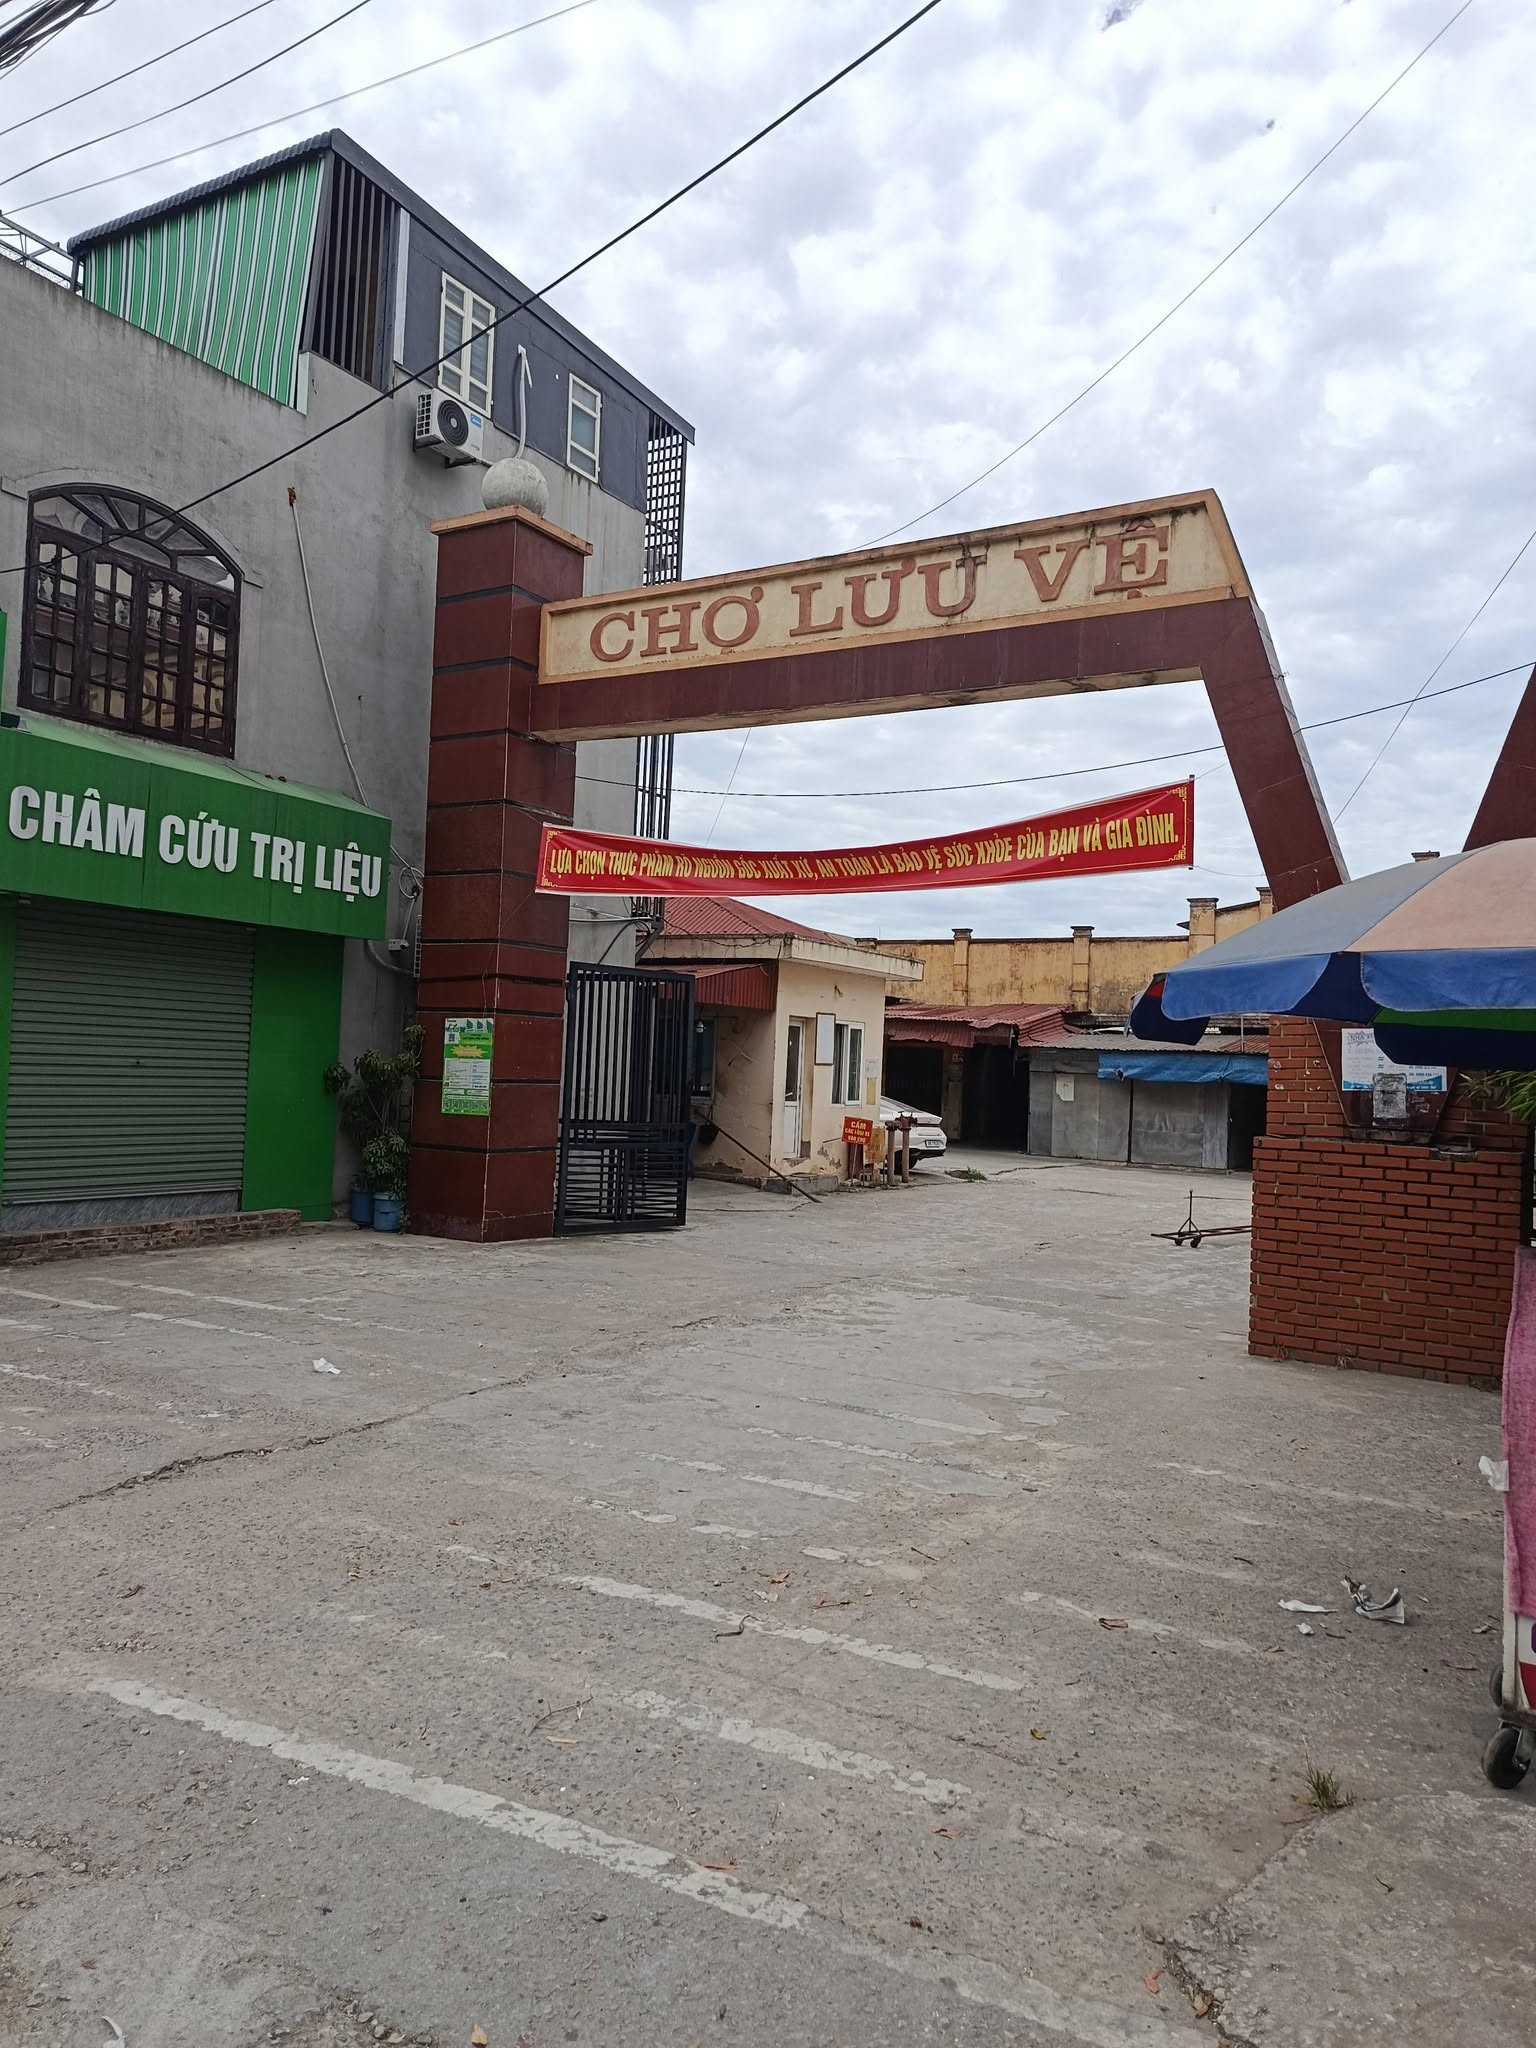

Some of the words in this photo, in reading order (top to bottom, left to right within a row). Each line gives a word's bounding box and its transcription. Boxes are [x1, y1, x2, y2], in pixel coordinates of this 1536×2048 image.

[789, 555, 987, 637] LƯU
[1014, 518, 1170, 602] VỆ
[8, 785, 146, 858] CHÂM
[158, 811, 239, 873] CỨU
[251, 832, 305, 894] TRỊ
[314, 842, 382, 903] LIỆU
[550, 848, 572, 879] LỰA
[575, 850, 607, 880] CHỌN
[608, 850, 638, 881] THỰC
[639, 848, 674, 877] PHẨM
[675, 853, 693, 878] RÕ
[733, 854, 762, 879] GỐC
[757, 854, 794, 879] XUẤT
[791, 856, 818, 881] XỨ,
[815, 858, 839, 878] AN
[834, 853, 875, 876] TOÀN
[871, 851, 894, 874] LÀ
[890, 847, 924, 873] BẢO
[922, 845, 943, 874] VỆ
[943, 841, 974, 868] SỨC
[974, 832, 1013, 865] KHỎE
[1016, 827, 1045, 861] CỦA
[1048, 825, 1080, 861] BẠN
[1082, 817, 1103, 852] VÀ
[1105, 818, 1133, 850] GIA
[1135, 809, 1179, 847] ĐÌNH.
